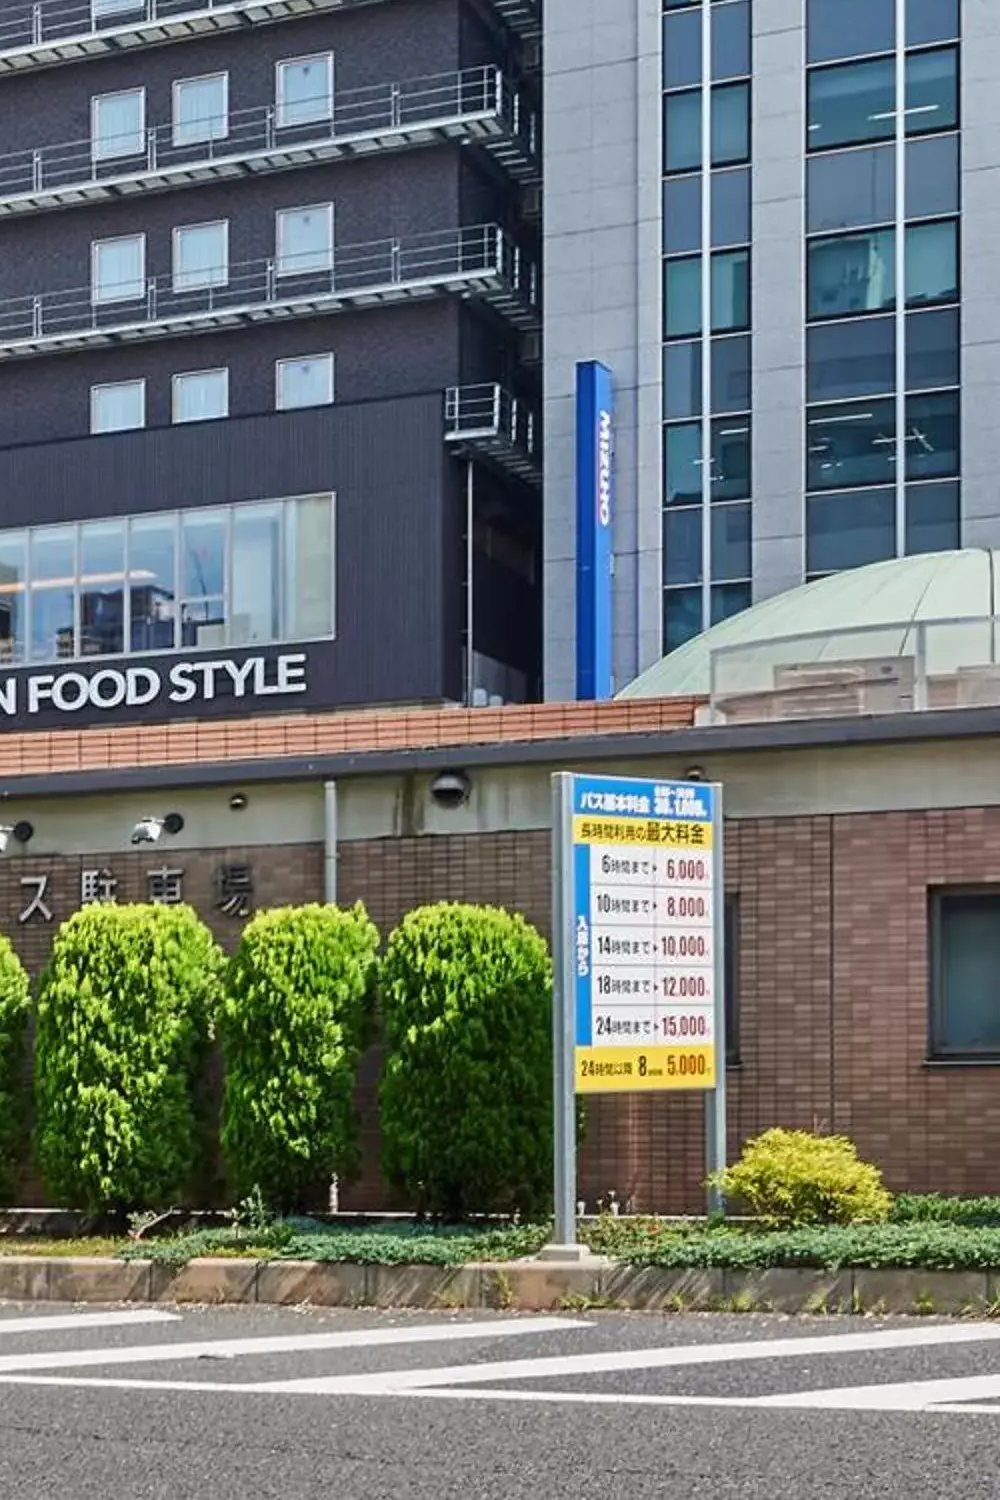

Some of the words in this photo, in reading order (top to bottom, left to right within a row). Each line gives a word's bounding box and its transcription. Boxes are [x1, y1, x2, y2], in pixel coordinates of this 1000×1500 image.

[599, 409, 611, 527] MIZUHO
[28, 668, 160, 713] FOOD
[169, 653, 307, 702] STYLE
[601, 854, 649, 874] 6時間まで
[667, 858, 709, 880] 6,000
[597, 893, 649, 913] 10時間まで
[667, 896, 709, 918] 8,000
[598, 935, 650, 955] 14時間まで
[662, 935, 709, 957] 10,000
[598, 975, 650, 994] 18時間まで
[662, 976, 710, 997] 12,000
[596, 1016, 650, 1035] 24時間まで
[662, 1016, 710, 1037] 15,000
[667, 1054, 711, 1076] 5,000
